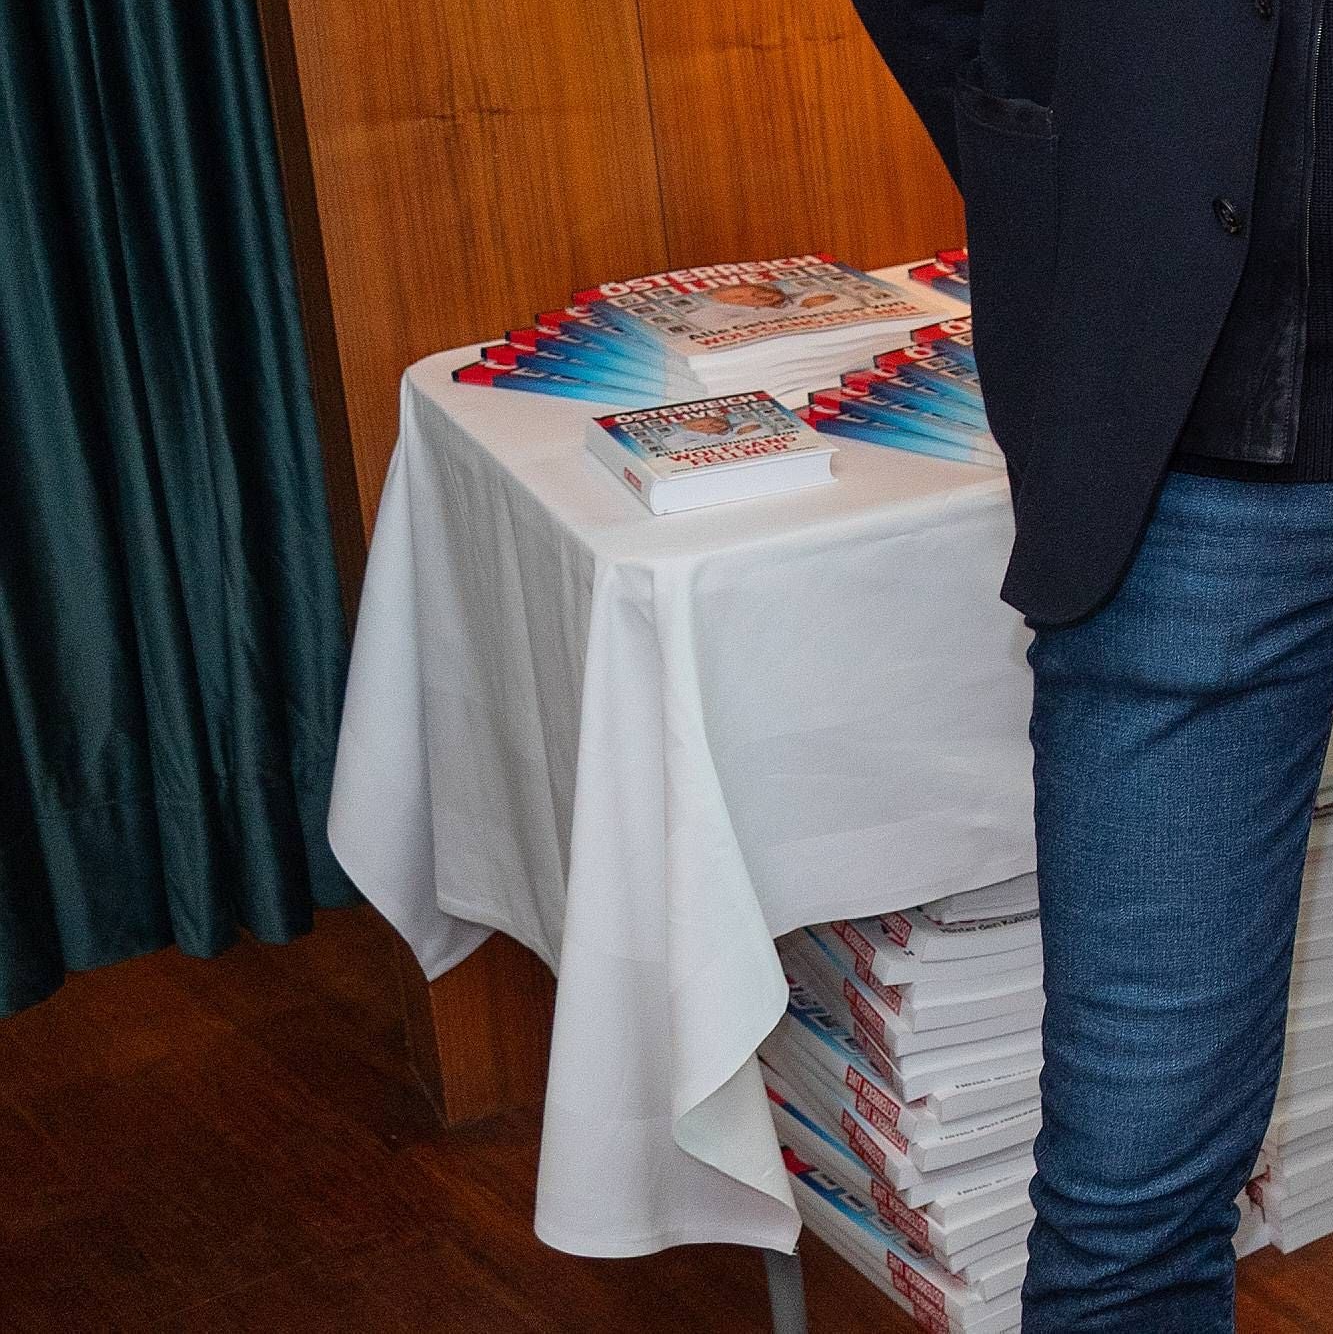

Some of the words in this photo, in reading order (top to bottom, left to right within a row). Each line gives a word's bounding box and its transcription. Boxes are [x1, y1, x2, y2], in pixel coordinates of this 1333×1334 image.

[682, 273, 772, 293] LIVE
[667, 408, 724, 423] LIVE
[669, 435, 797, 462] WOLFGANG
[690, 443, 788, 466] FELLNER
